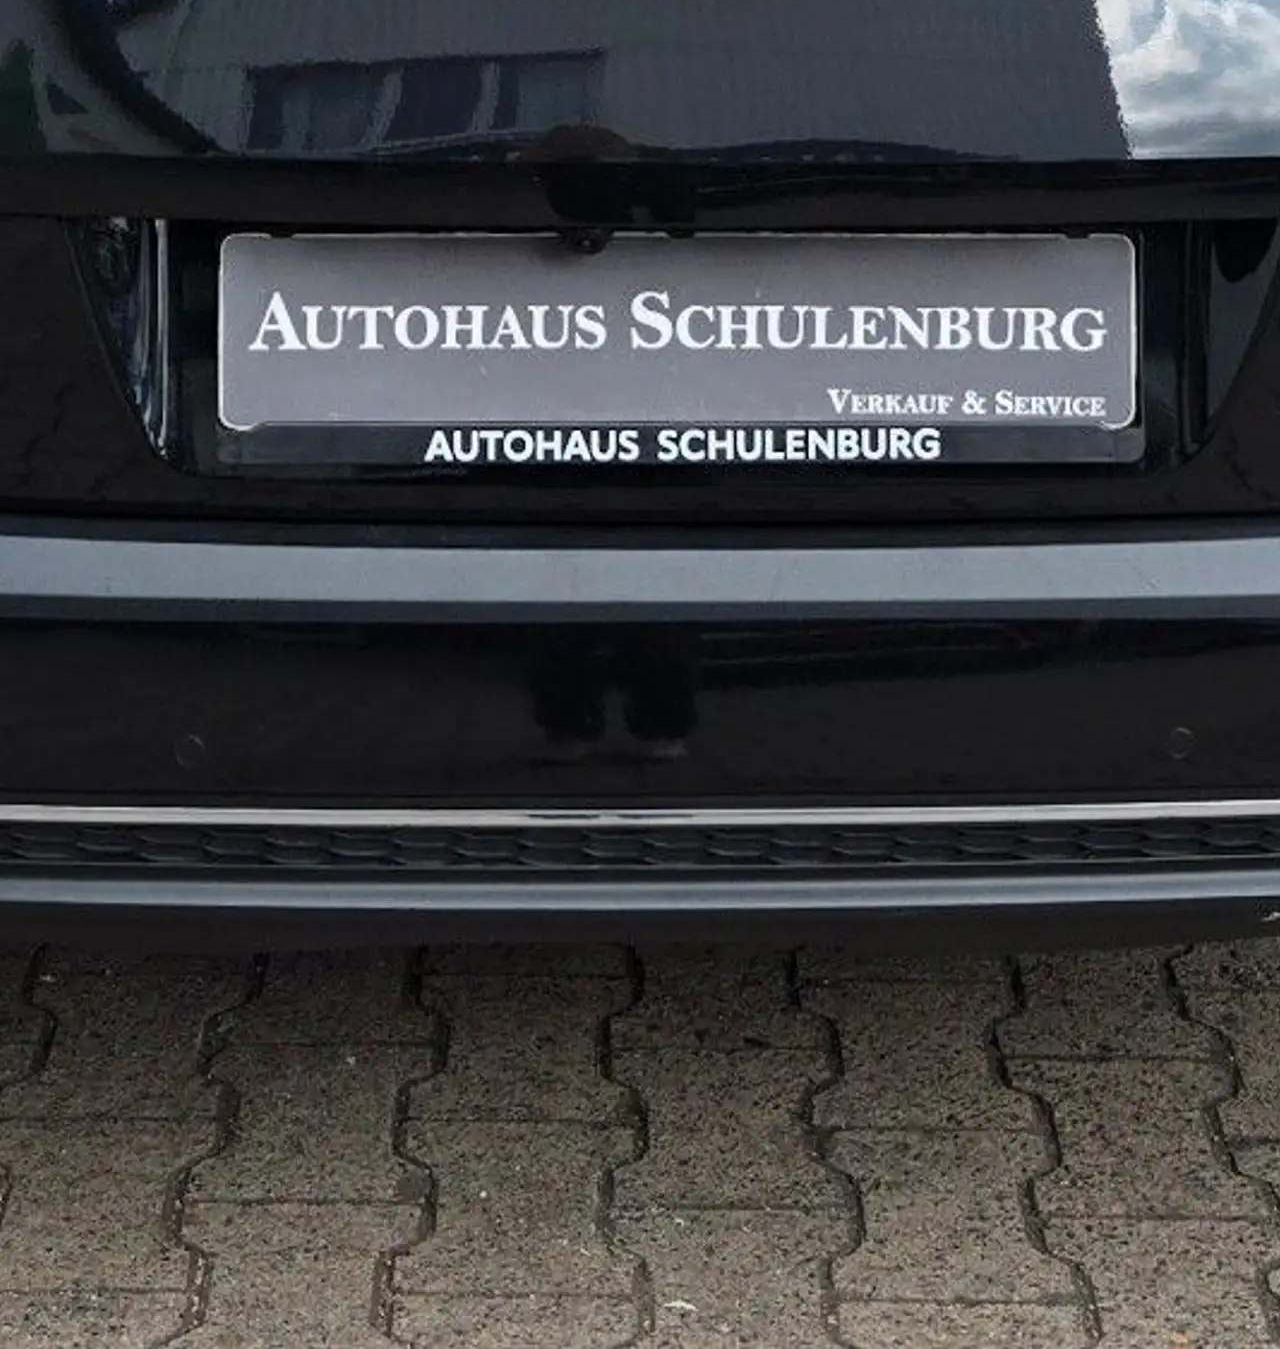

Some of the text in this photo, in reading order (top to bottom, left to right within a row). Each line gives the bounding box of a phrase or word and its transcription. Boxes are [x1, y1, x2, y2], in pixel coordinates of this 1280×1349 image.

[248, 289, 1109, 353] AUTOHAUS SCHULENBURG
[826, 386, 1108, 418] VERKAUF & SERVICE
[423, 428, 943, 463] AUTOHAUS SCHULENBURG
